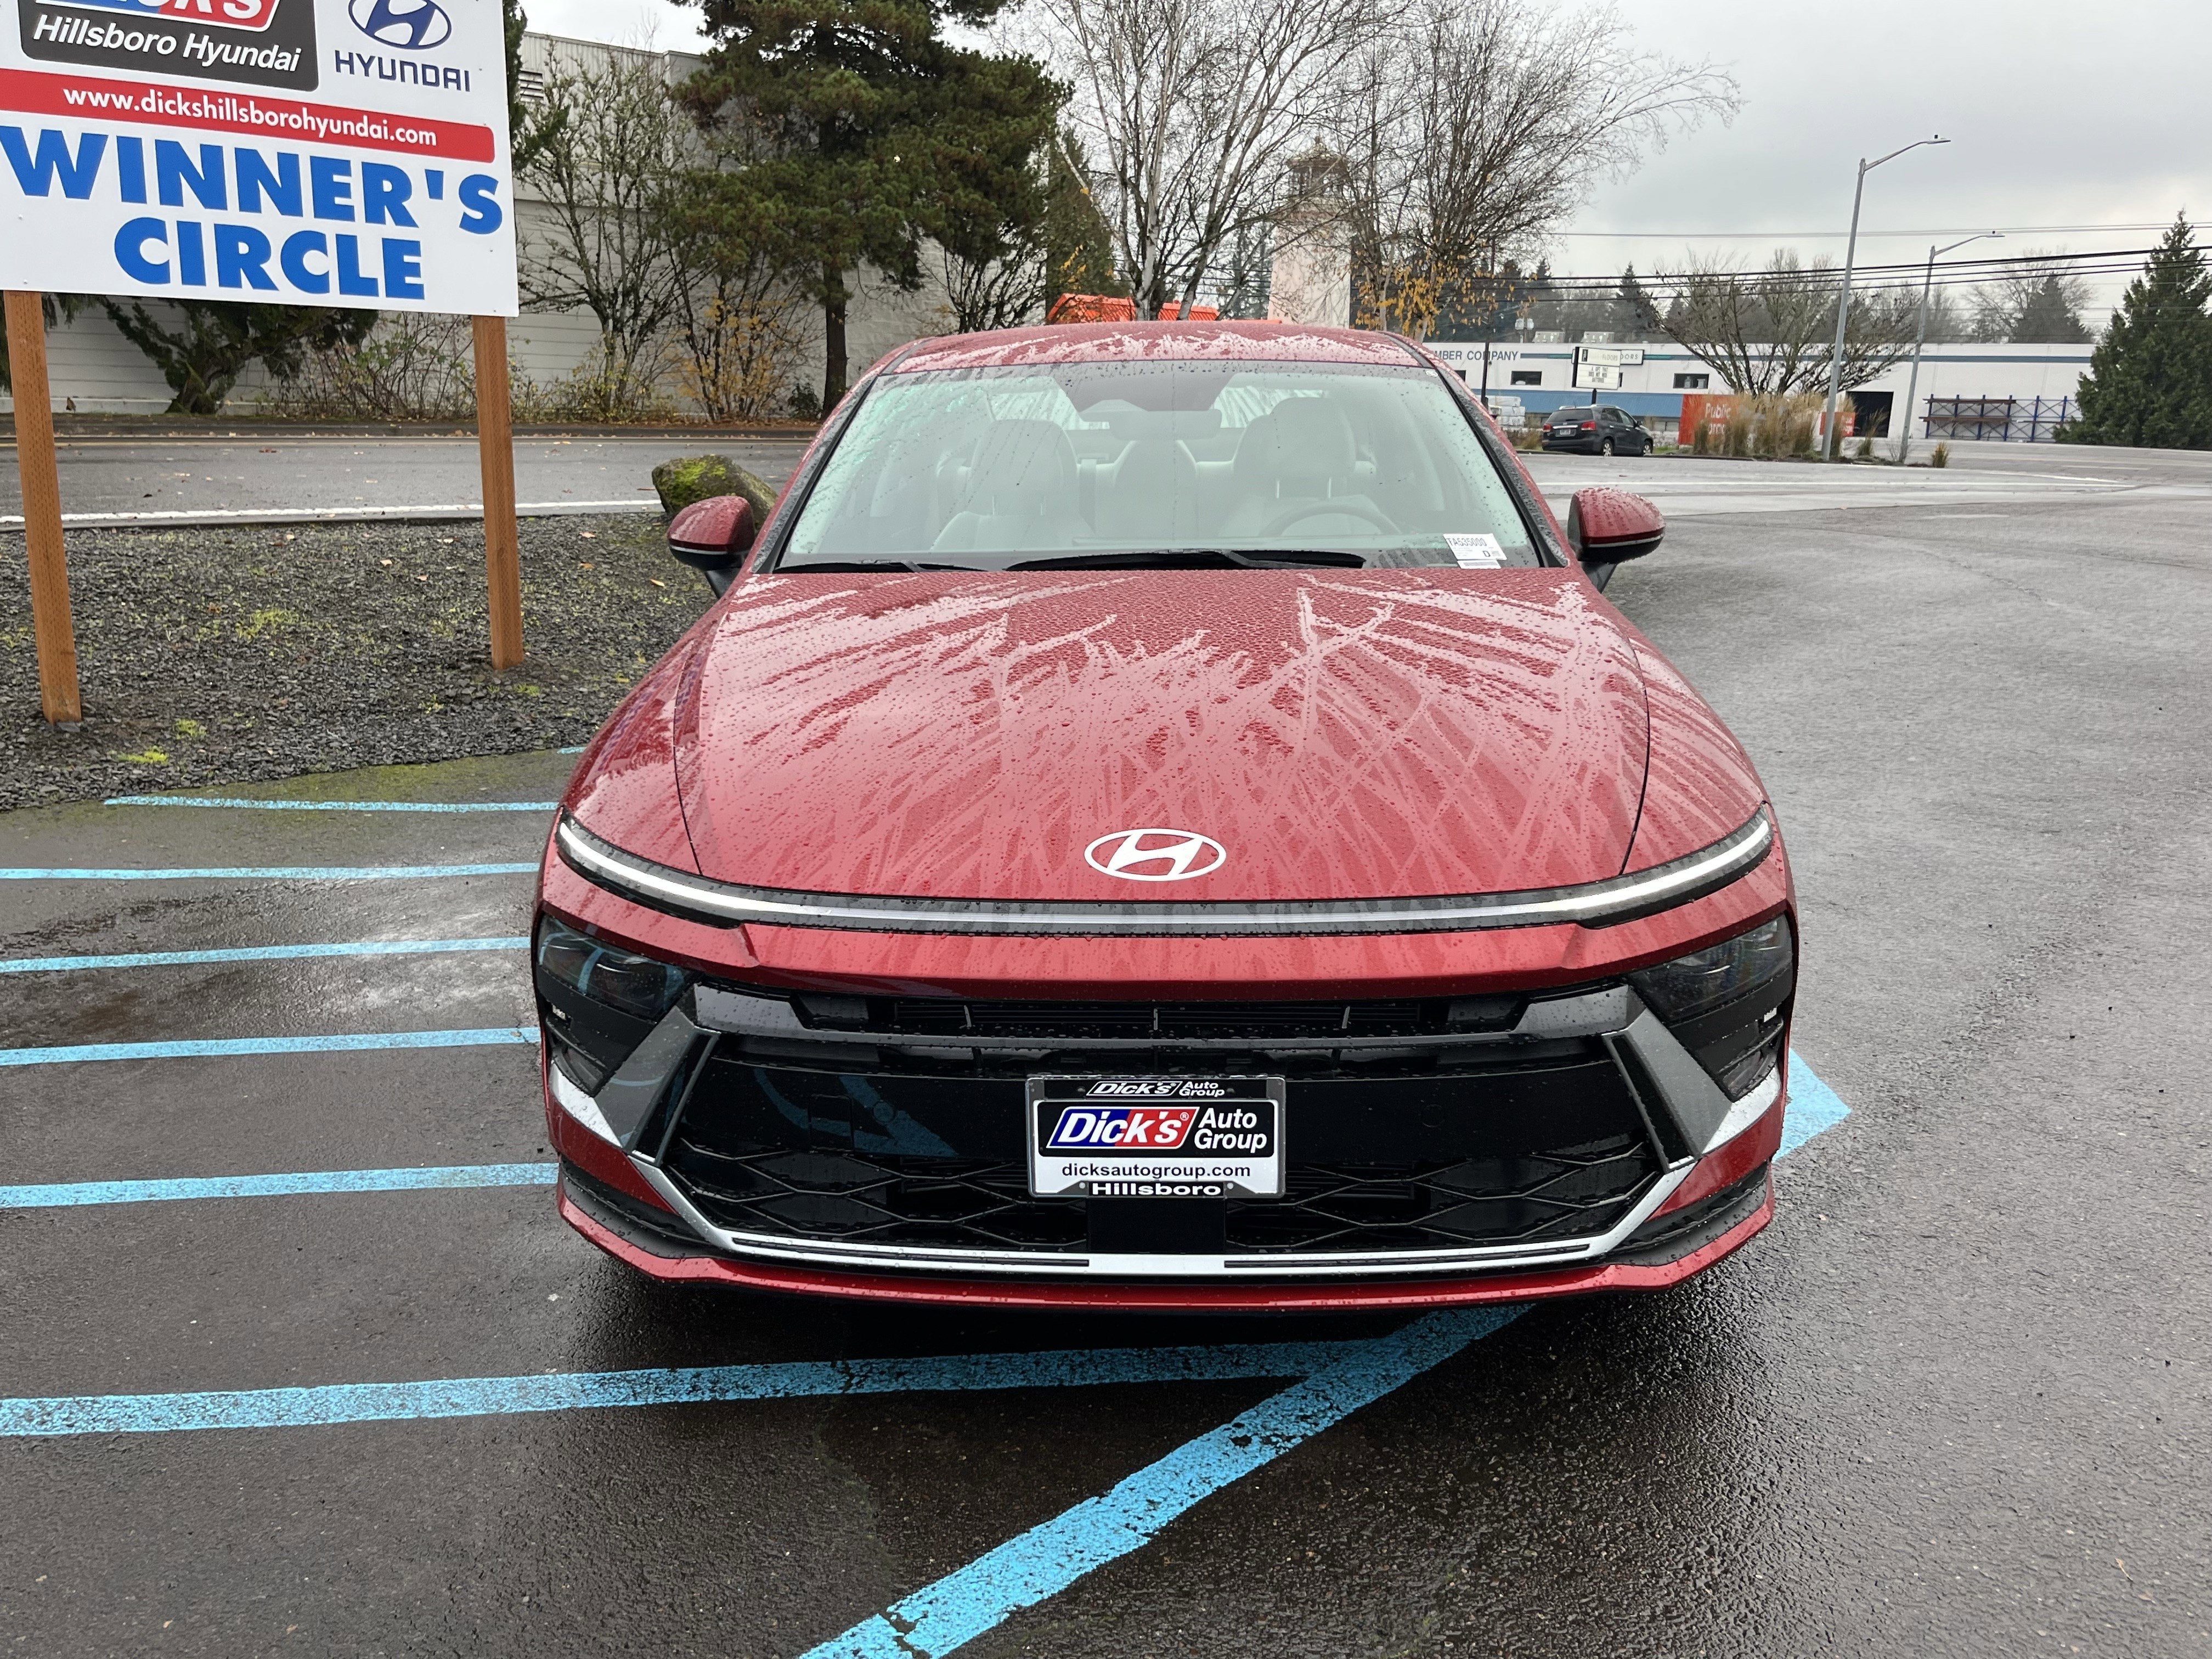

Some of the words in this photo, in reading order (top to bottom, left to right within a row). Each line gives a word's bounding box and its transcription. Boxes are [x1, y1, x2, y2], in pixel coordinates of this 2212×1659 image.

[33, 14, 177, 55] Hillsboro
[183, 33, 302, 72] Hyundai
[334, 49, 471, 92] HYUNDAI
[63, 87, 437, 147] www.dickshillsborohyundai.com
[0, 126, 503, 235] WINNER'S
[114, 217, 425, 300] CIRCLE
[1179, 1088, 1225, 1097] Group
[1182, 1081, 1218, 1089] Auto
[1198, 1108, 1257, 1129] Auto
[1194, 1128, 1267, 1154] Group
[1062, 1163, 1251, 1179] dicksautogroup.com
[1092, 1182, 1221, 1195] Hillsboro
